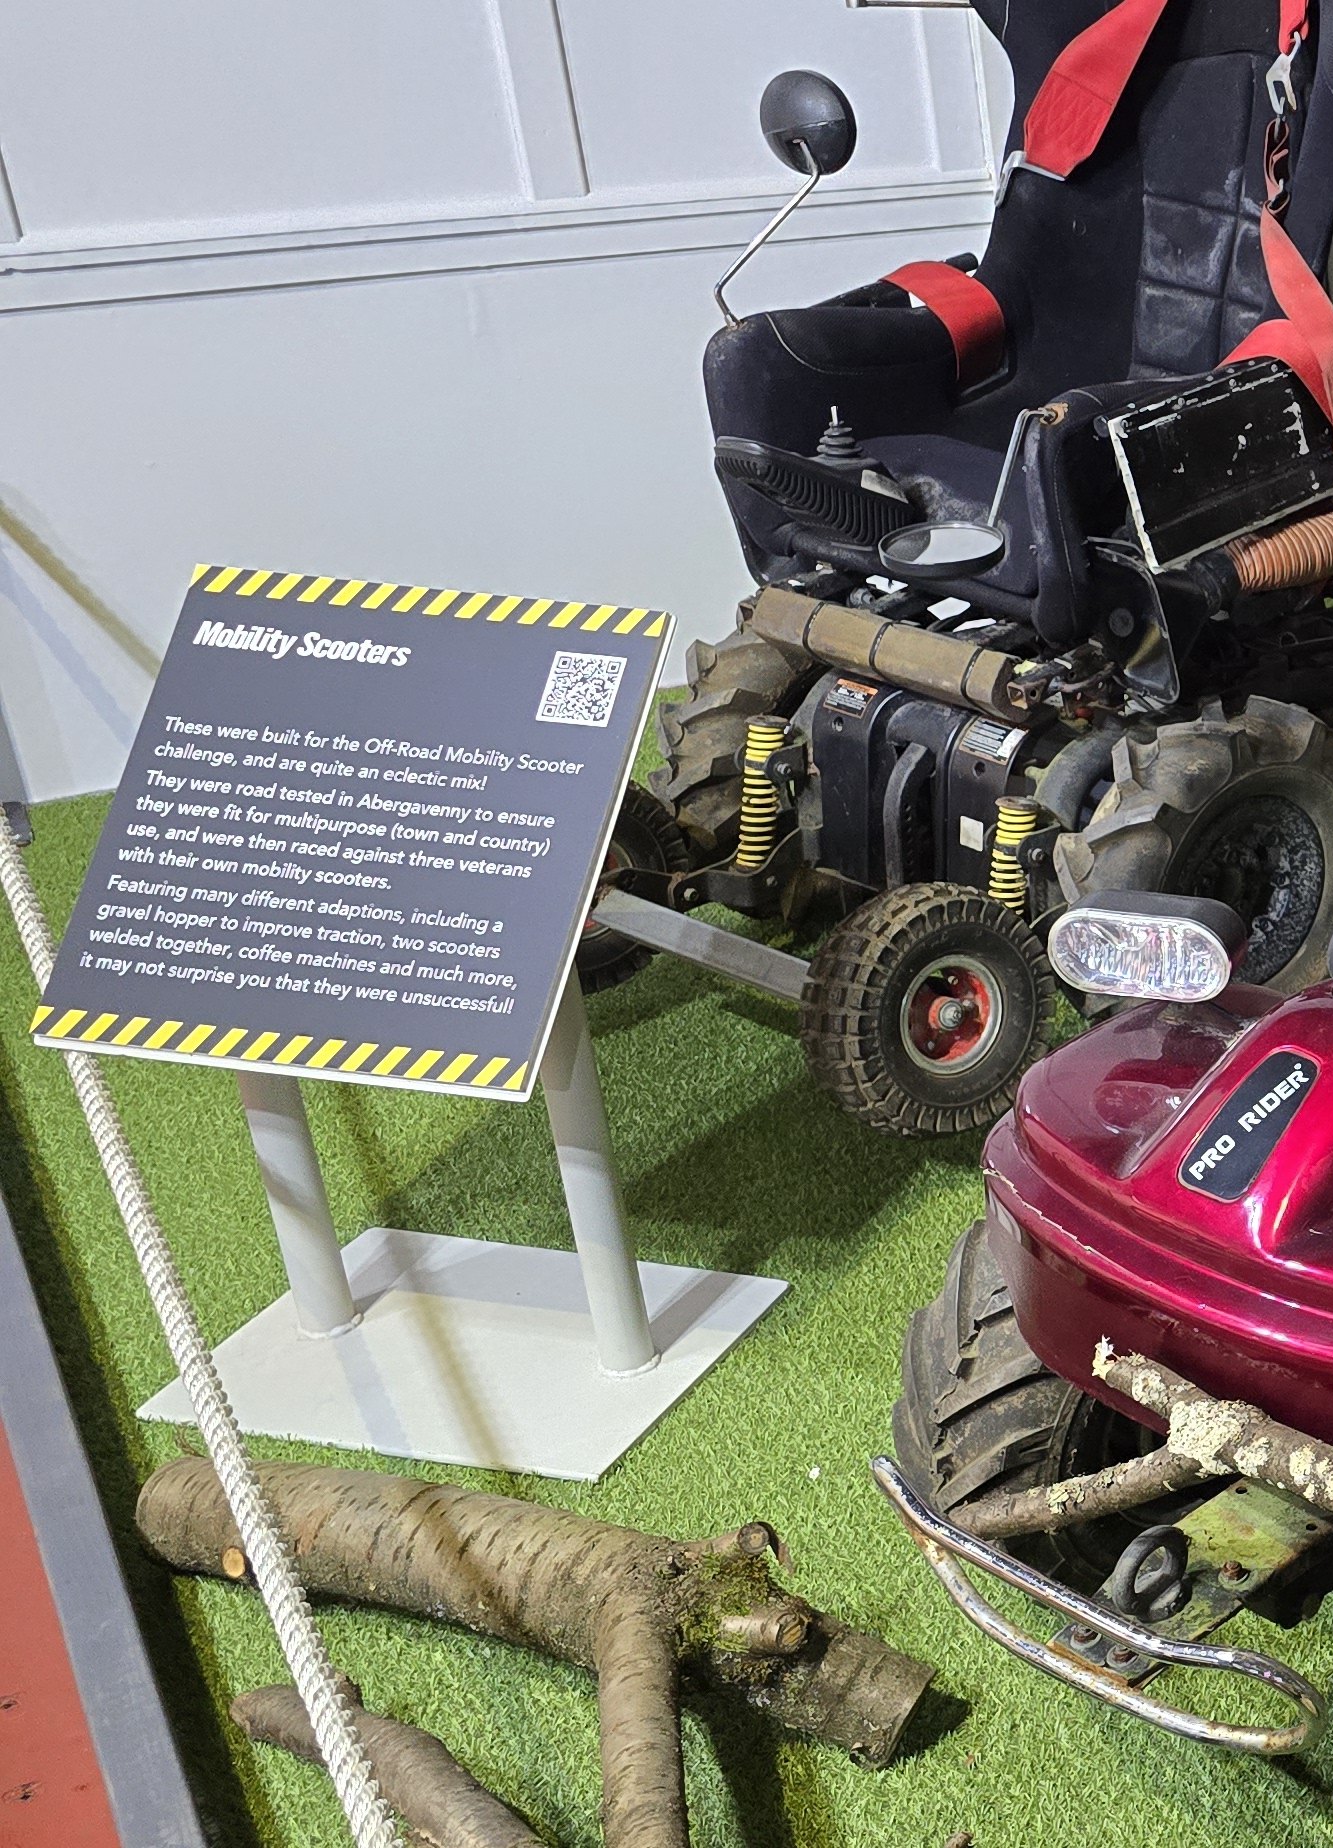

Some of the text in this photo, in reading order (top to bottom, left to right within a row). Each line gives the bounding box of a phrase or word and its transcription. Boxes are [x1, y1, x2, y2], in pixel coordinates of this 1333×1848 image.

[192, 620, 411, 666] Mobility Scooters
[154, 740, 487, 790] challenge, and are quite an eclectic mix!
[165, 715, 584, 774] These were built for the Off-Road Mobility Scooter
[136, 794, 550, 857] they were fit for multipurpose (town and country)
[146, 769, 555, 828] They were road tested in Abergavenny to ensure
[118, 846, 391, 889] with their own mobility scooters.
[126, 823, 532, 878] use, and were then raced against three veterans
[96, 904, 500, 958] gravel hopper to improve traction, two scooters
[107, 874, 503, 935] Featuring many different adaptions, including a
[79, 951, 514, 1014] it may not surprise you that they were unsuccessful!
[89, 927, 517, 990] welded together, coffee machines and much more,
[1188, 1069, 1310, 1181] PRO RIDER
